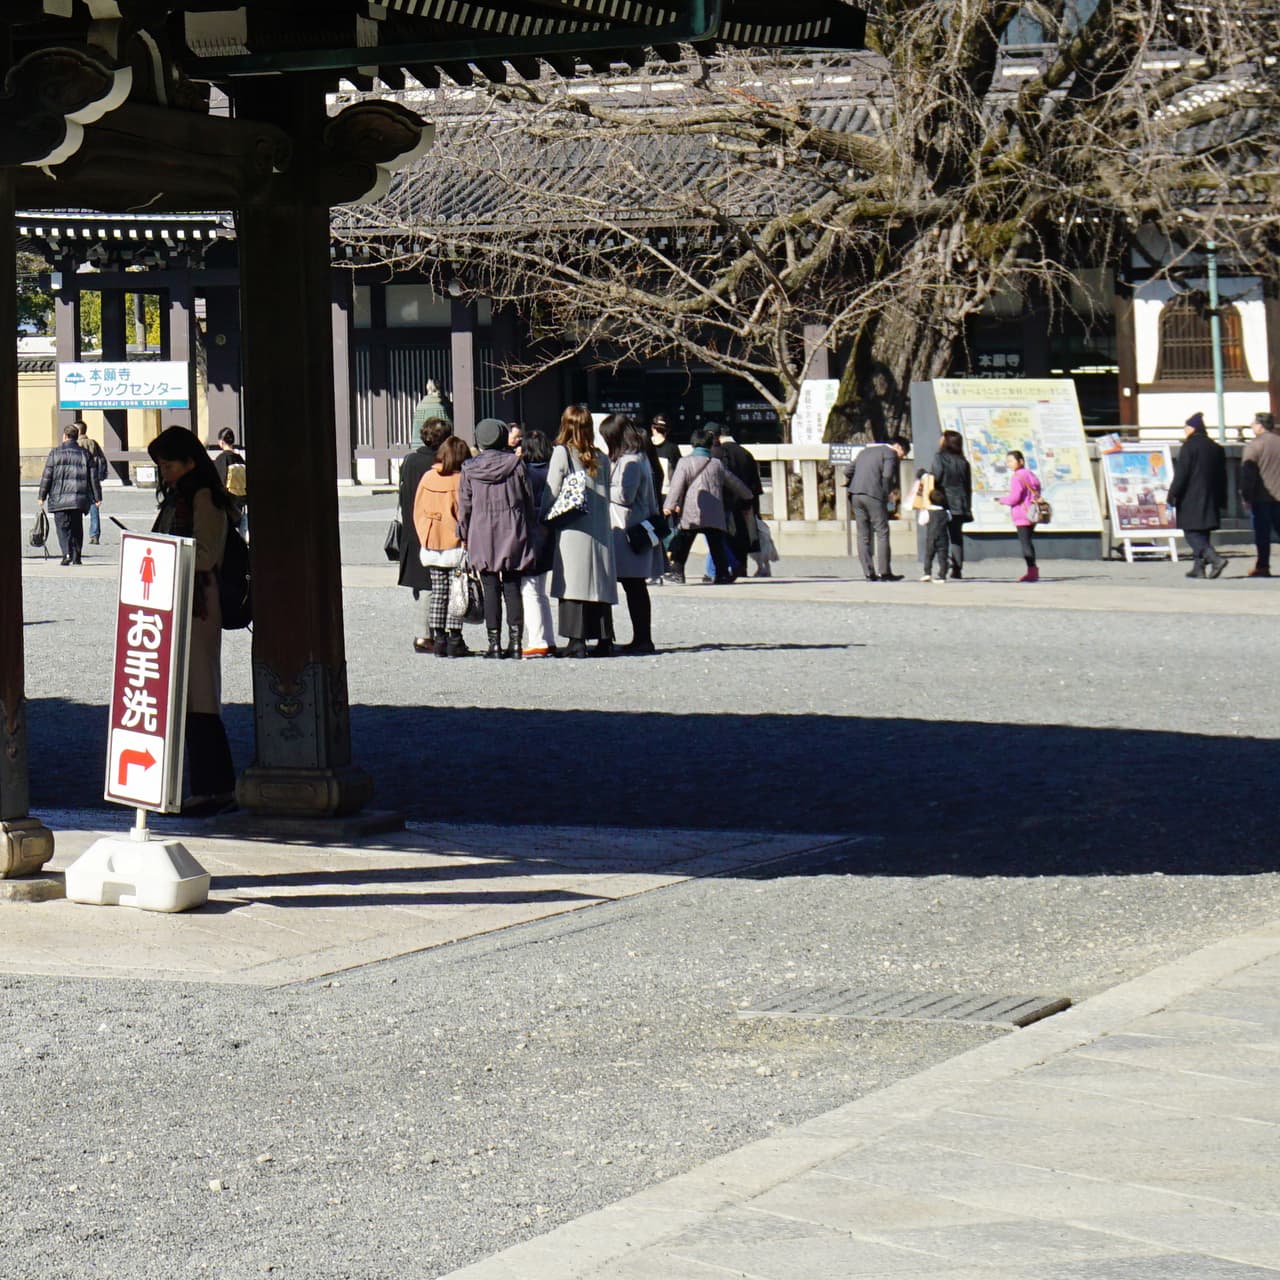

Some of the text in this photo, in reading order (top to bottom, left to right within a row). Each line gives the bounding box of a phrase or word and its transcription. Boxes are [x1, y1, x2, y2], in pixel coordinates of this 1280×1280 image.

[89, 367, 131, 382] 本願寺
[90, 382, 183, 397] ブックセンター
[121, 609, 163, 732] お手洗
